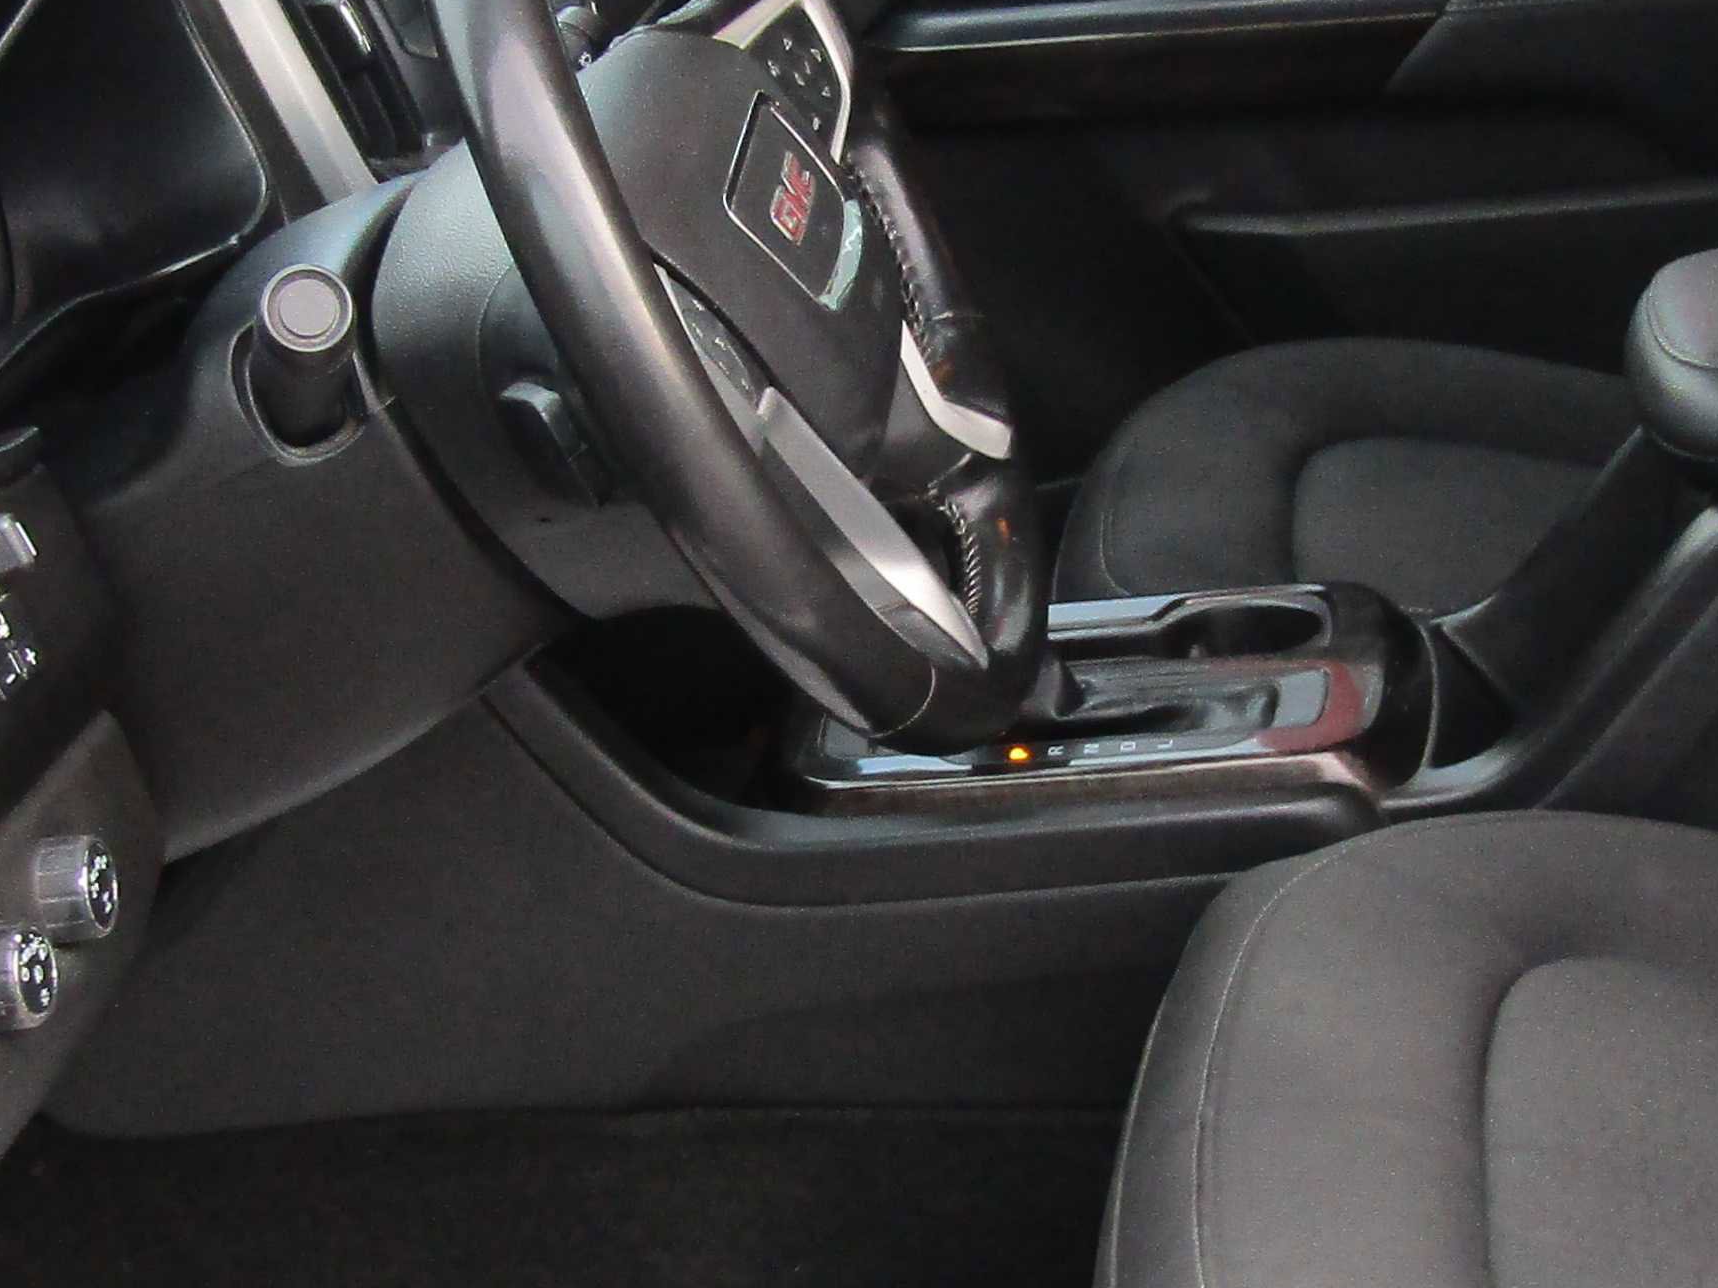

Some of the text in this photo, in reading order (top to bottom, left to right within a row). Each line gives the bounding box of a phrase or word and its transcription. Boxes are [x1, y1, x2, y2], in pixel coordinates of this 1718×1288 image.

[769, 151, 816, 246] GMC
[1047, 745, 1064, 757] R
[1083, 743, 1099, 755] N
[1120, 740, 1136, 752] D
